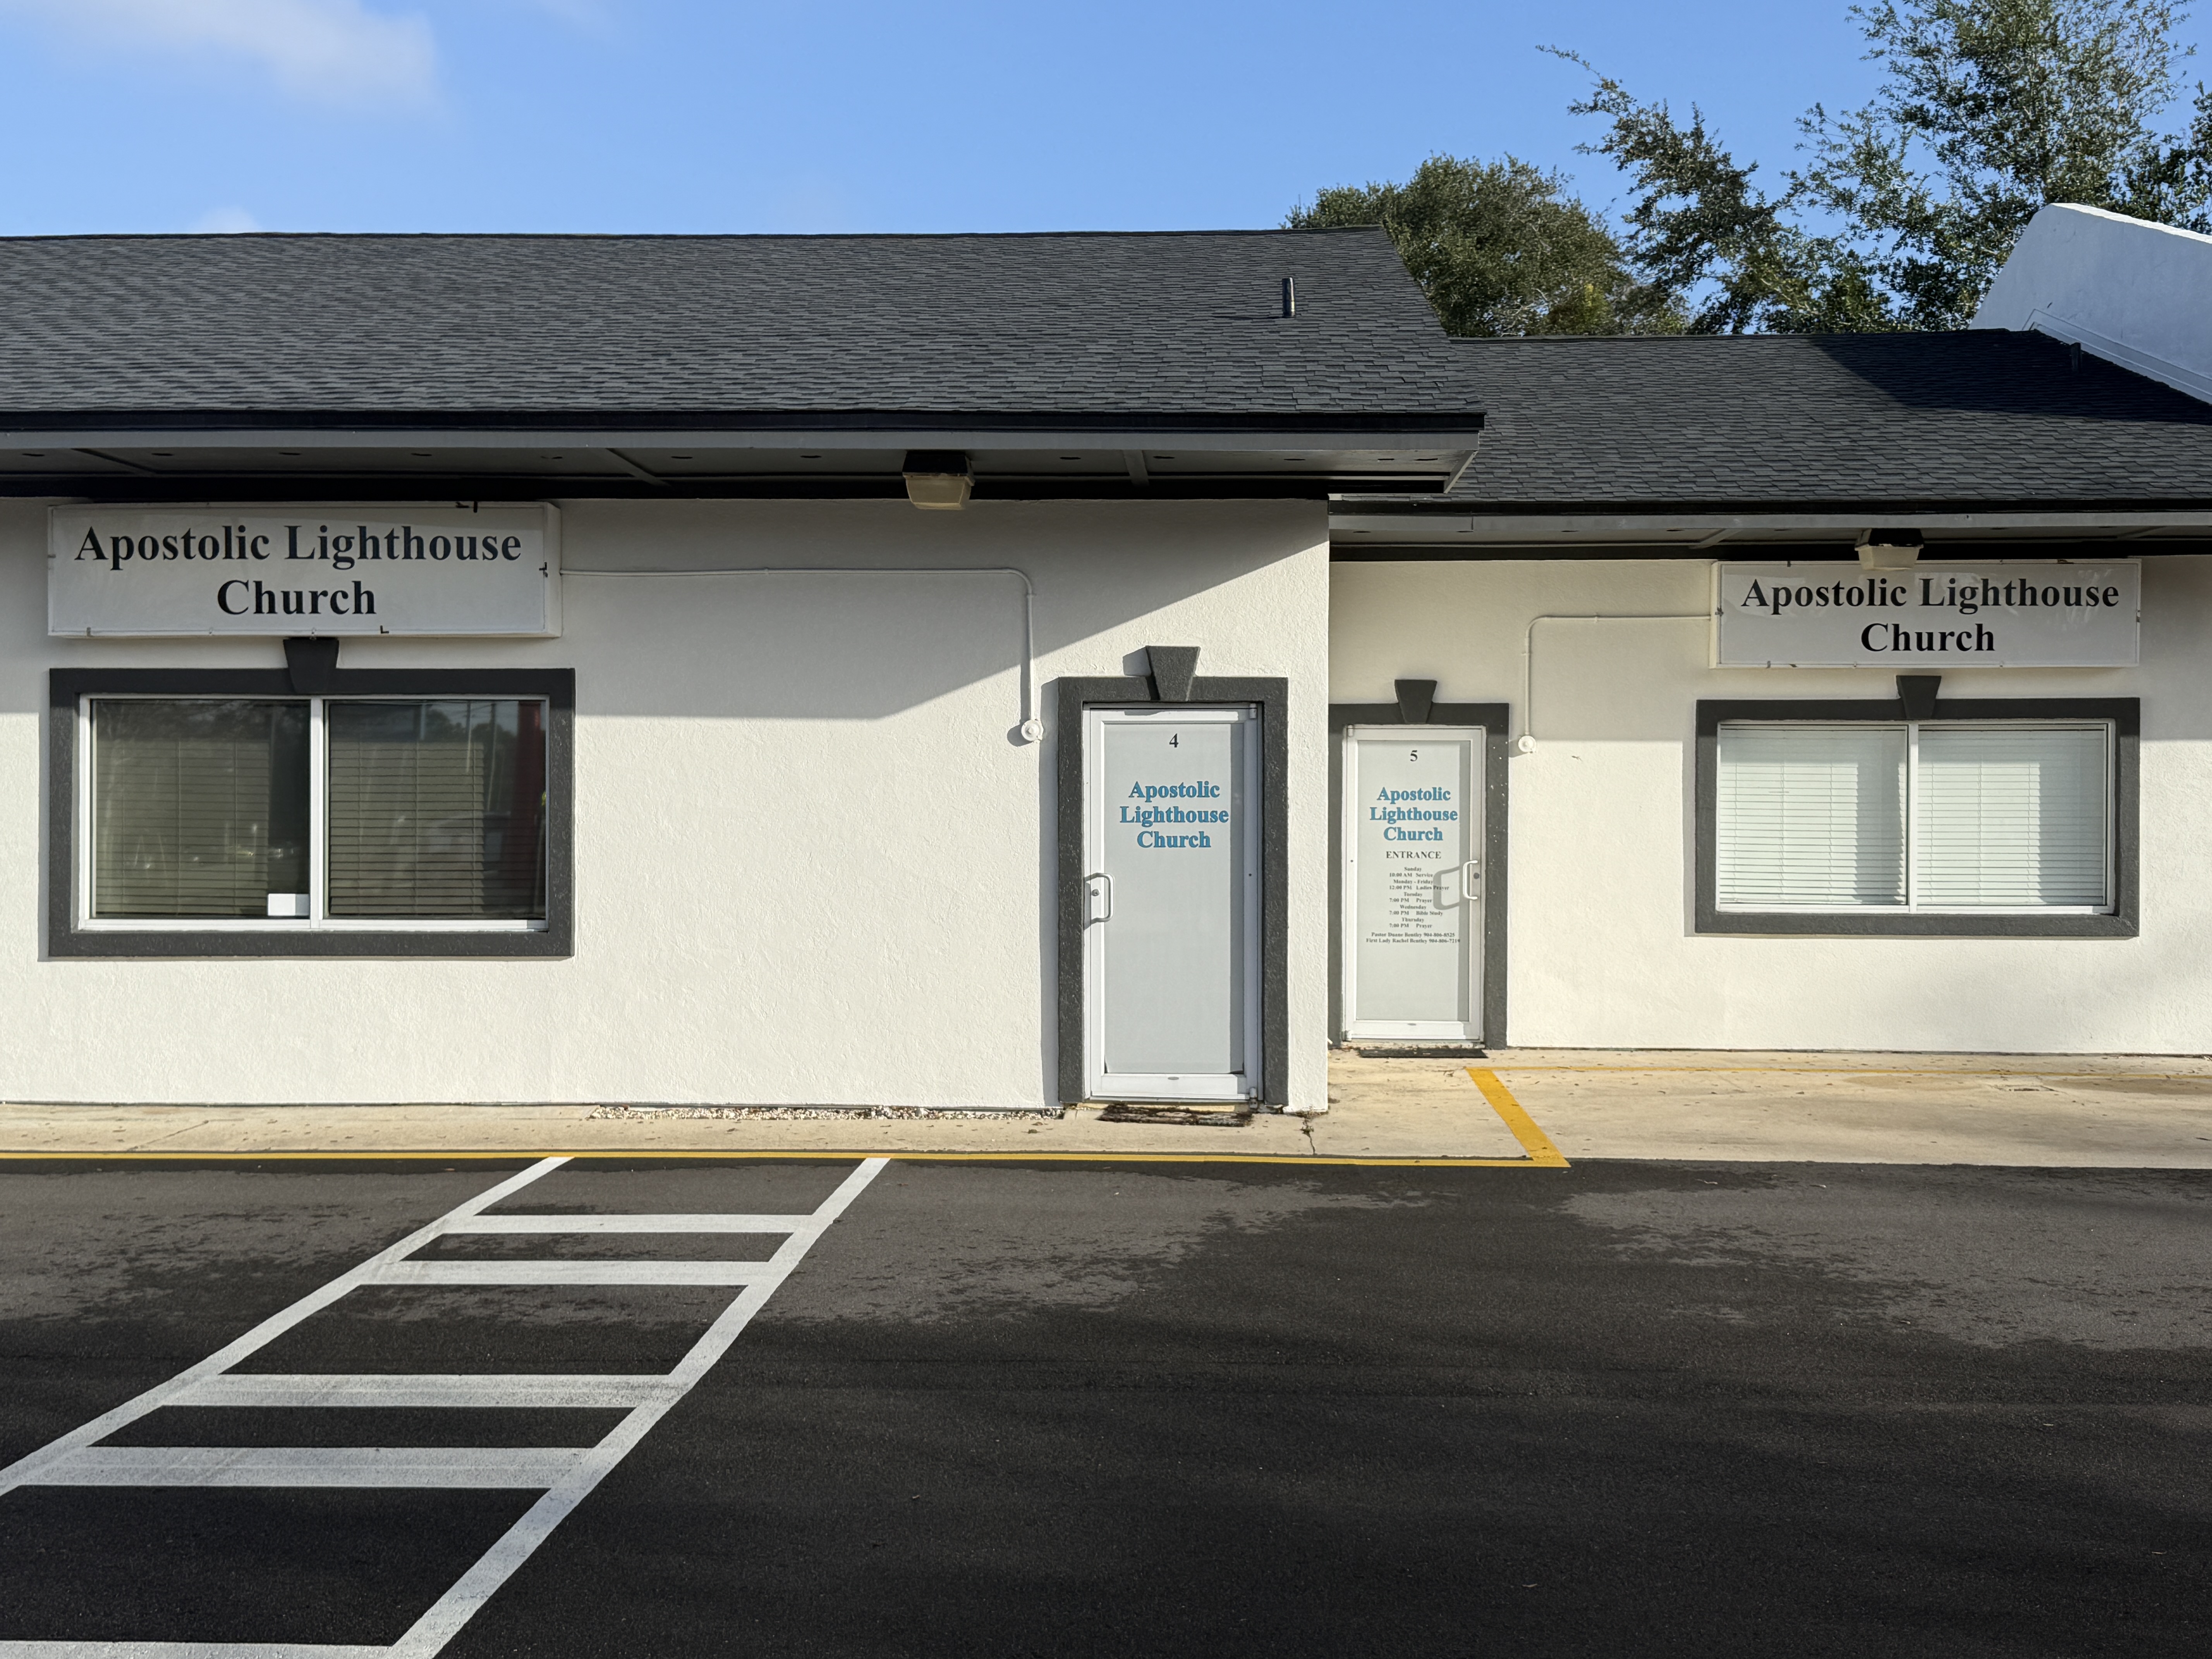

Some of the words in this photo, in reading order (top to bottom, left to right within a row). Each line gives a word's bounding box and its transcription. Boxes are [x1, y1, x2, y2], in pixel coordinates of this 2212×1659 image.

[74, 525, 270, 570] Apostolic
[284, 525, 521, 570] Lighthouse
[217, 579, 376, 615] Church
[1741, 578, 1907, 615] Apostolic
[1919, 578, 2119, 614] Lighthouse
[1861, 623, 1995, 651] Church
[1169, 733, 1179, 748] 4
[1410, 750, 1418, 761] 5
[1128, 781, 1220, 802] Apostolic
[1377, 787, 1451, 804] Apostolic
[1120, 806, 1229, 827] Lighthouse
[1369, 807, 1458, 824] Lighthouse
[1137, 831, 1211, 848] Church
[1384, 827, 1443, 841] Church
